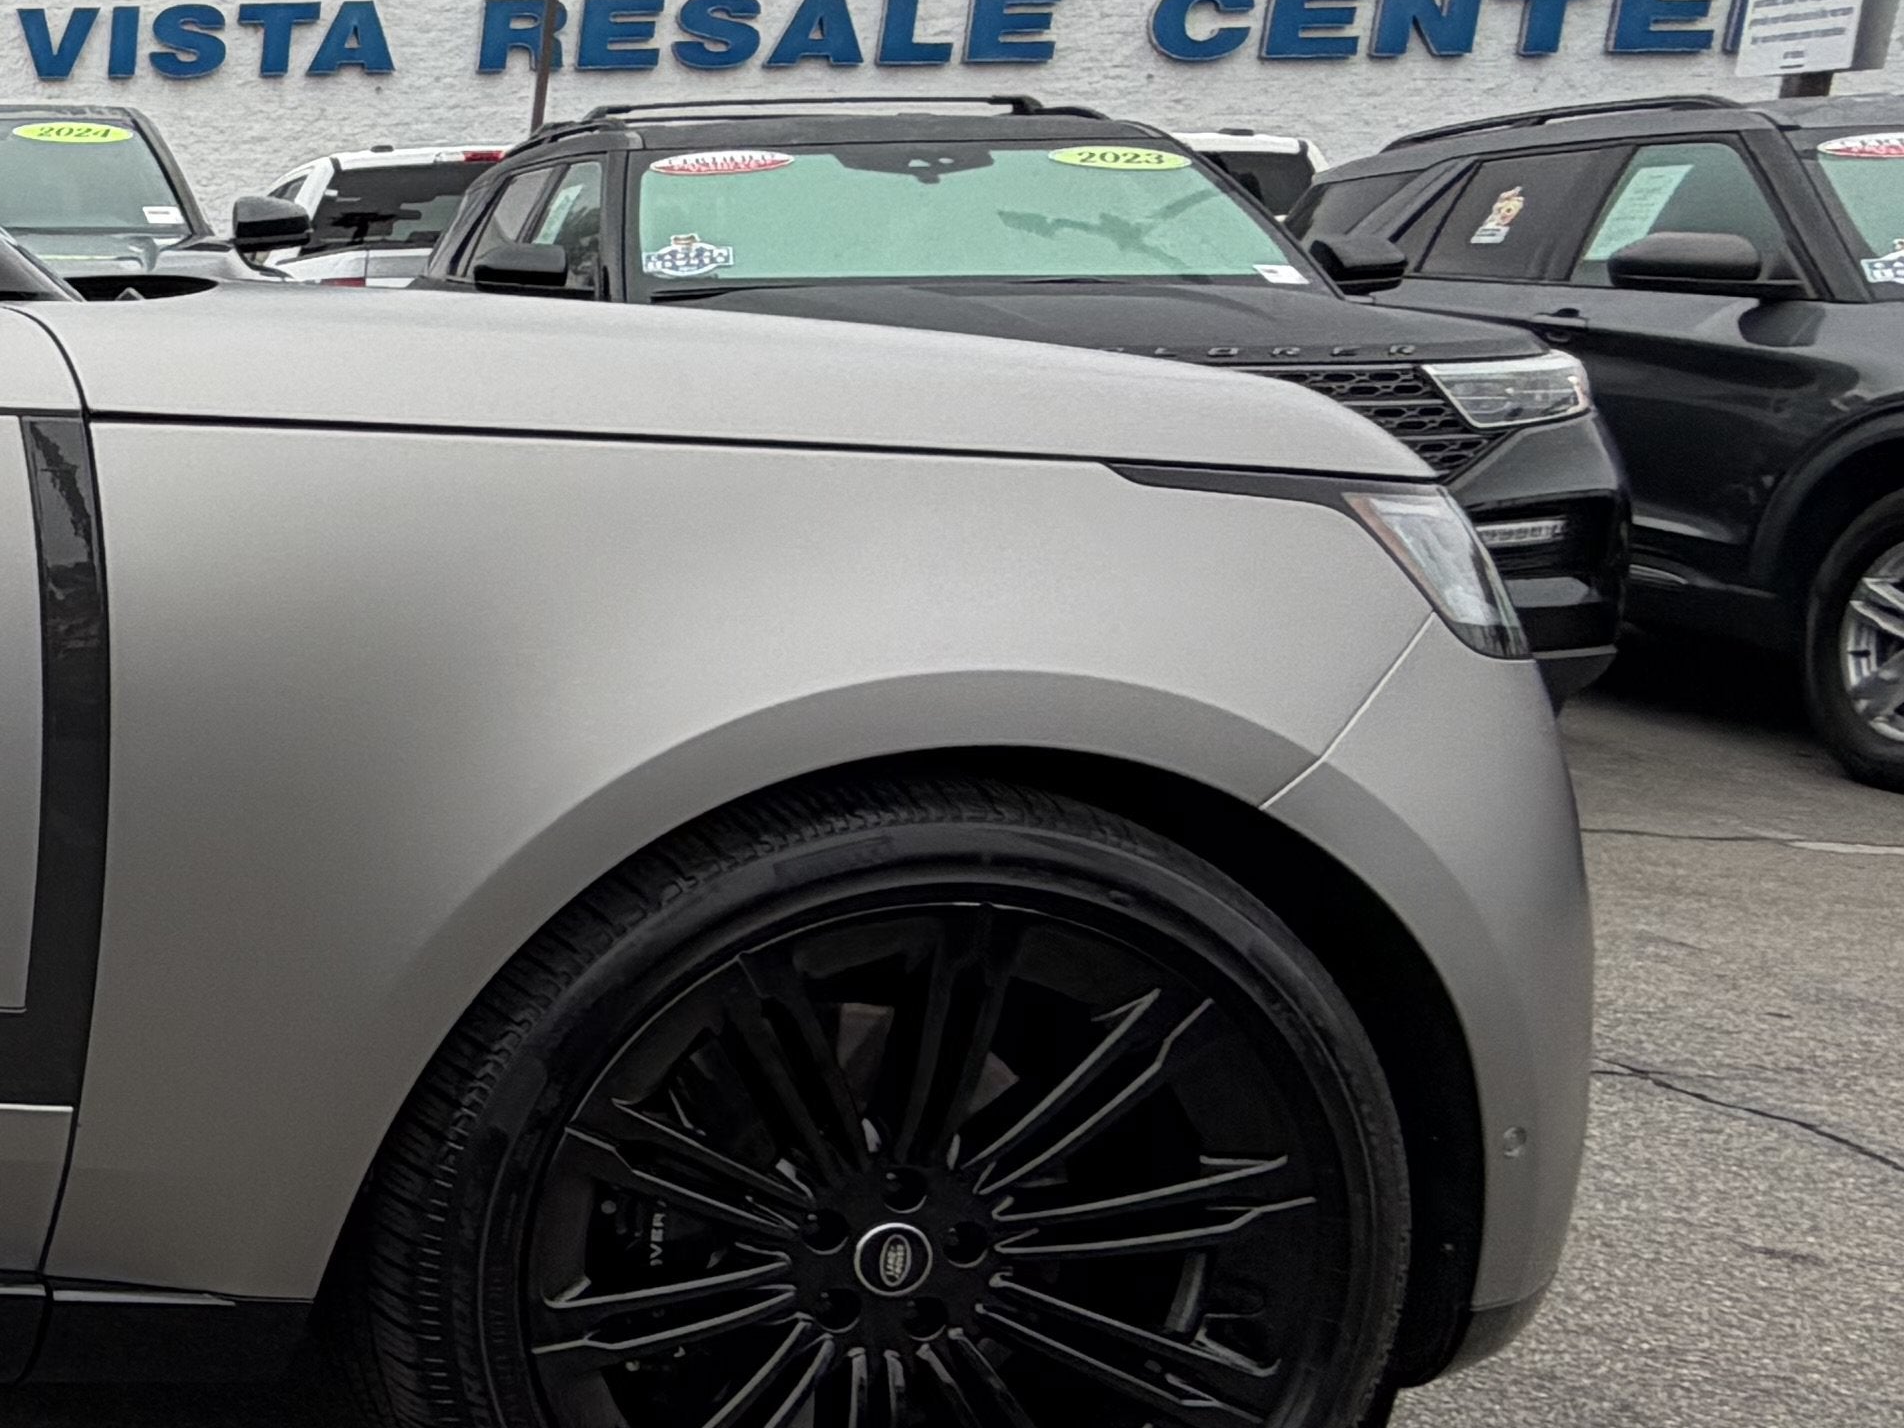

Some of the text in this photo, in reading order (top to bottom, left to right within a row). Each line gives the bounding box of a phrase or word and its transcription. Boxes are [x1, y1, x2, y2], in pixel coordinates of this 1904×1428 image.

[17, 0, 396, 81] VISTA
[37, 126, 111, 139] 2024
[1077, 151, 1165, 165] 2023
